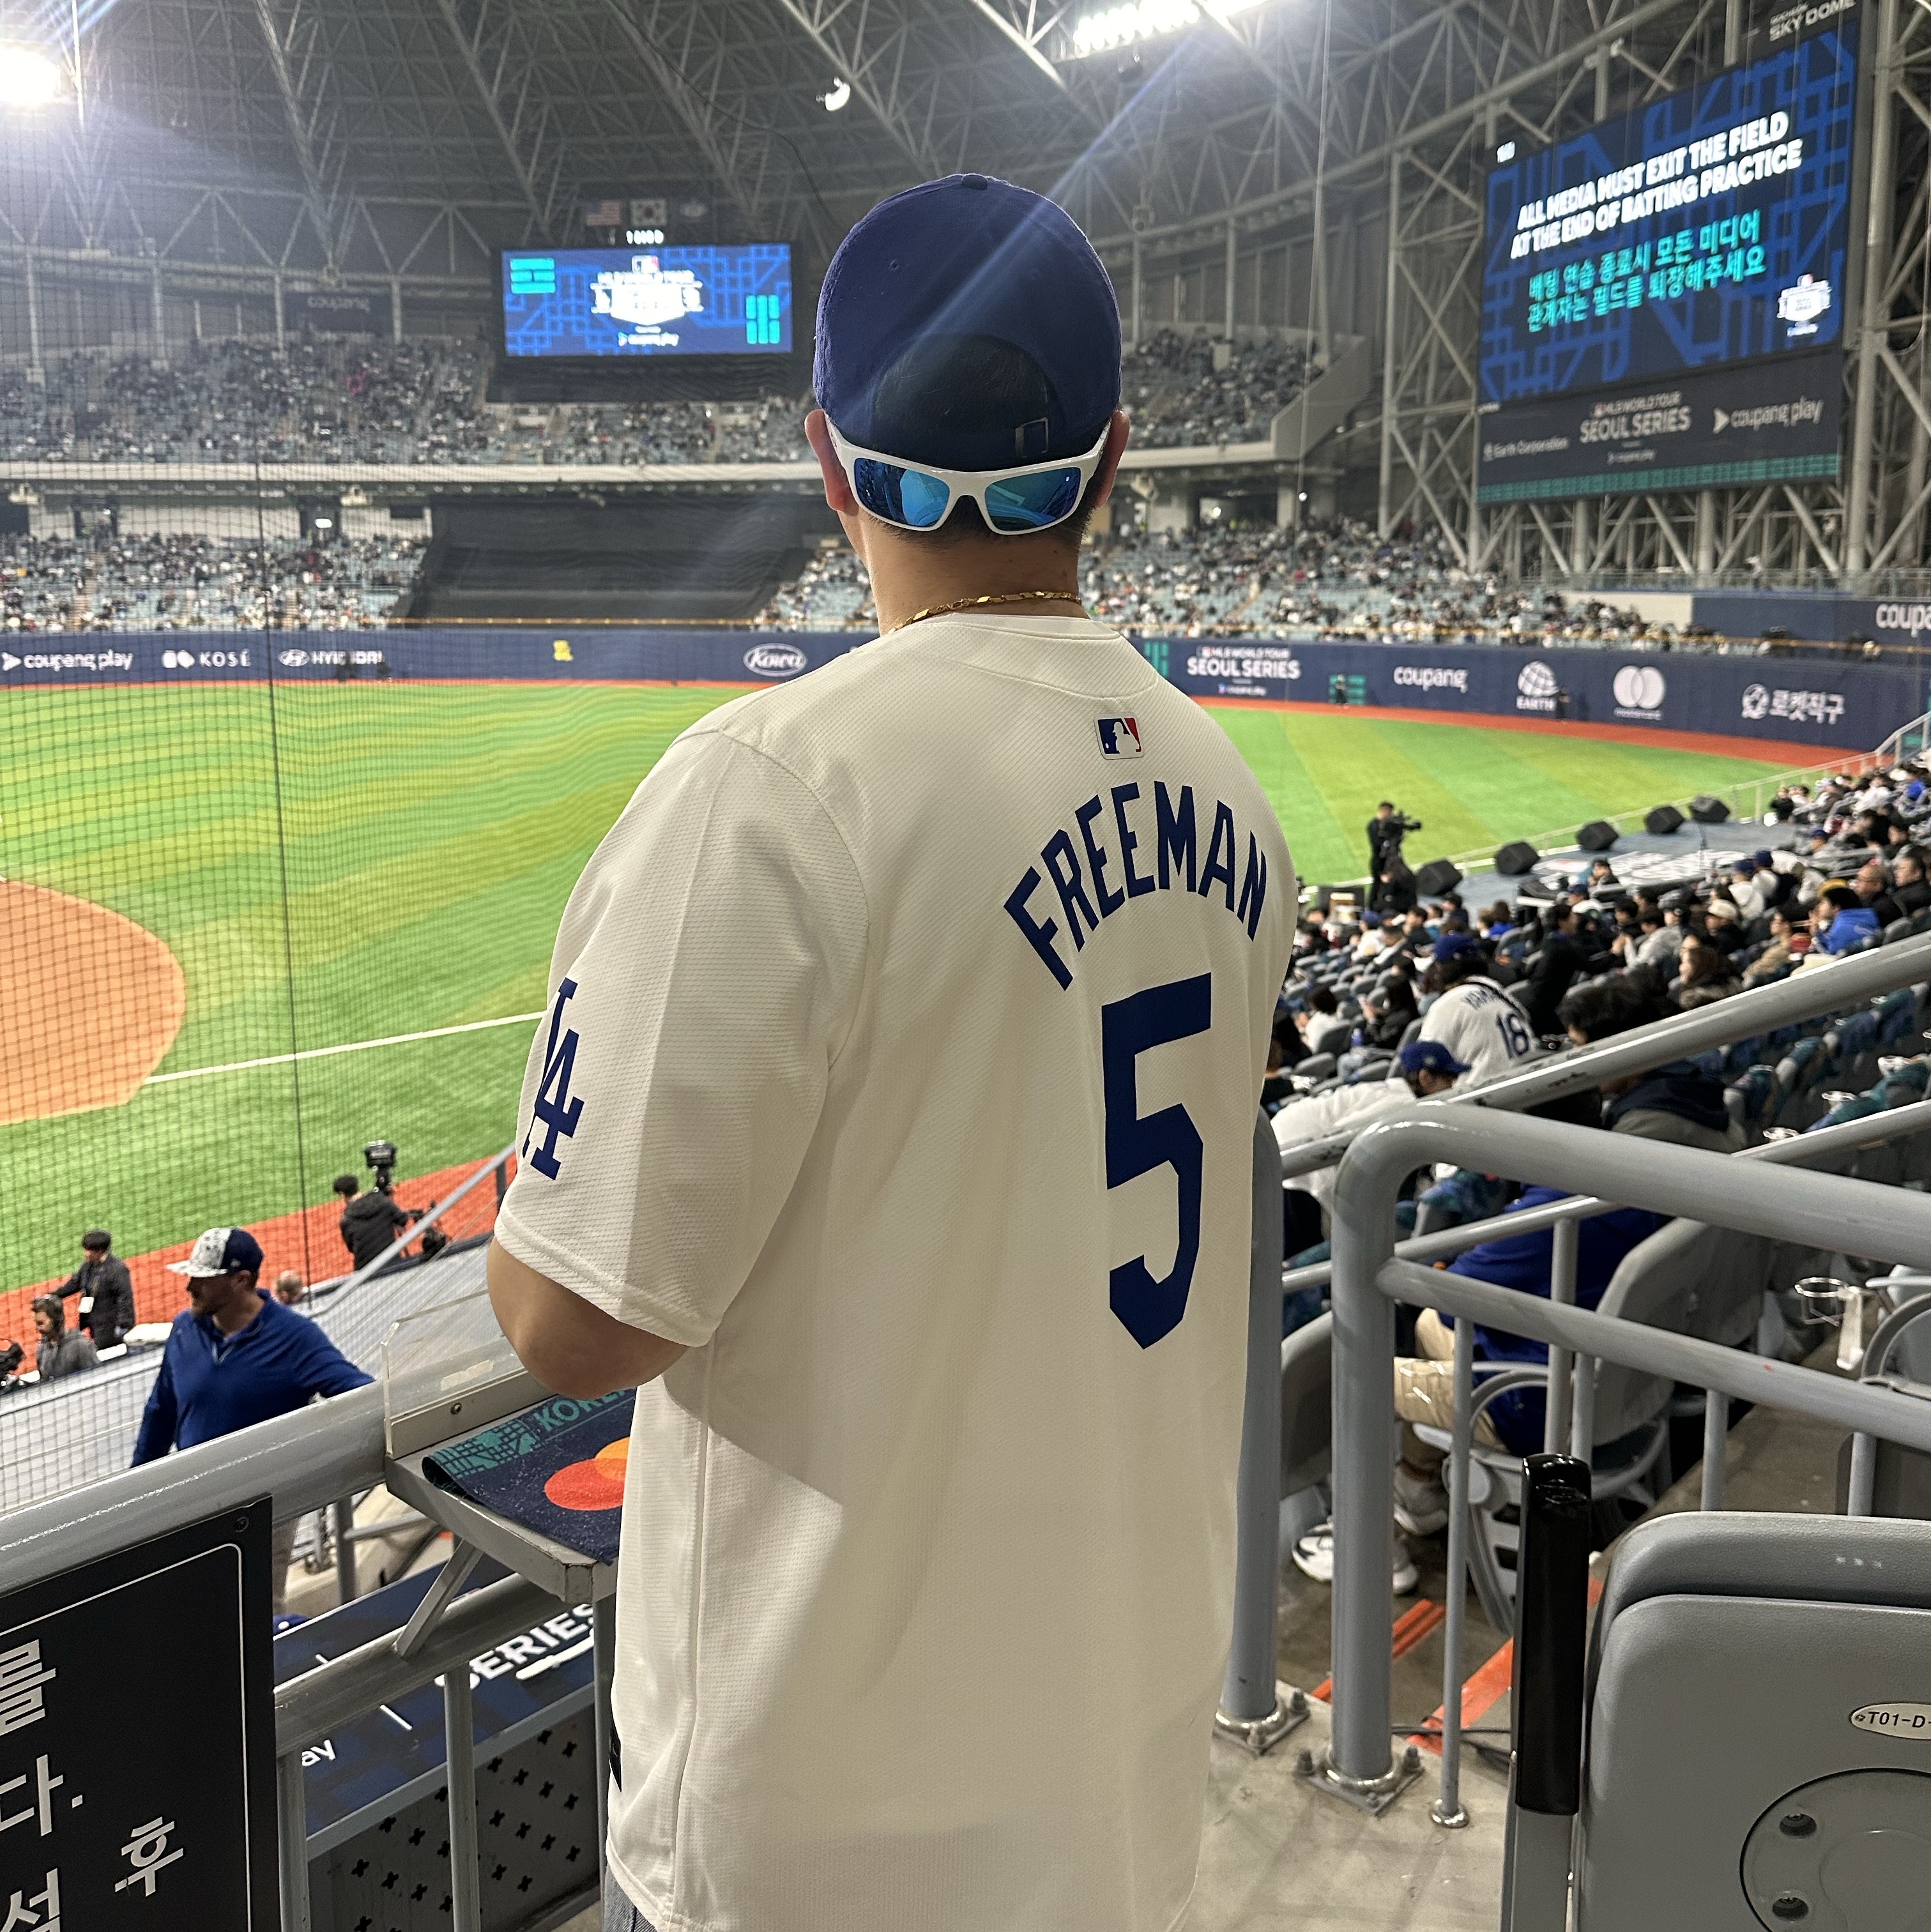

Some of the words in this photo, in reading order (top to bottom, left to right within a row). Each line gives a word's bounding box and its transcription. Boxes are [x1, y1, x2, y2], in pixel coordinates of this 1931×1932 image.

[1769, 14, 1804, 42] SKY
[1517, 200, 1546, 230] ALL
[1547, 181, 1596, 220] MEDIA
[1598, 161, 1645, 202] MUST
[1646, 147, 1688, 185] EXIT
[1689, 132, 1727, 169] THE
[1729, 111, 1789, 156] FIELD
[1511, 231, 1531, 259] AT
[1532, 221, 1561, 252] THE
[1561, 210, 1595, 243] END
[1596, 201, 1621, 231] OF
[1621, 175, 1698, 223] BATTING
[1700, 138, 1803, 198] PRACTICE
[1655, 229, 1694, 266] 모든
[1699, 208, 1760, 254] 미디어
[1592, 275, 1644, 316] 필드를
[1648, 245, 1767, 301] 퇴장해주세요
[1580, 415, 1629, 444] SEOUL
[1631, 405, 1692, 437] SERIES
[1730, 404, 1789, 431] coupang
[1790, 395, 1825, 427] play
[24, 652, 96, 672] coupang
[98, 648, 133, 671] play
[1187, 656, 1240, 677] SEOUL
[1242, 658, 1301, 680] SERIES
[1393, 666, 1469, 694] coupang
[1004, 780, 1269, 990] FREEMAN
[1495, 1012, 1529, 1061] 18
[1101, 973, 1212, 1350] 5
[301, 1739, 337, 1767] ay
[115, 1816, 184, 1897] 후
